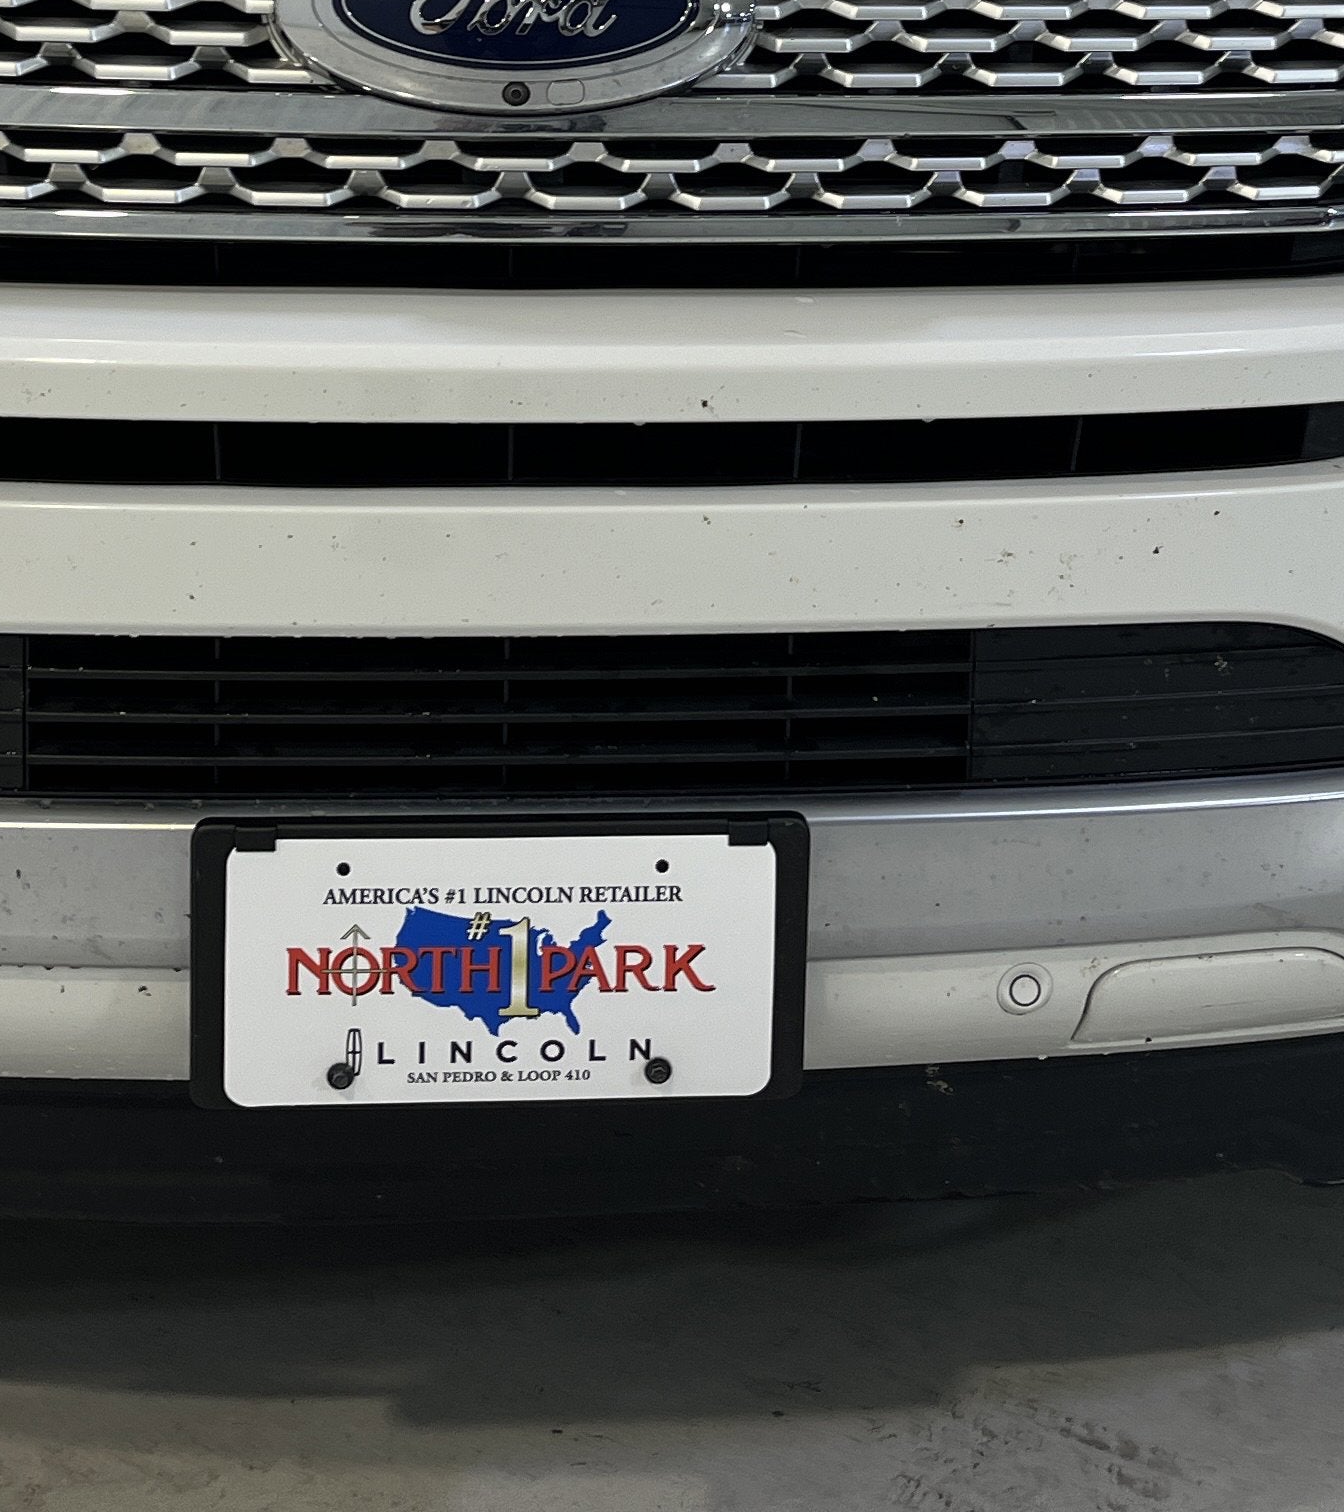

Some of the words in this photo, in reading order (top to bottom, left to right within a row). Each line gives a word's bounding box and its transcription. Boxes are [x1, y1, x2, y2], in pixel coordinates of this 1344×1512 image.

[322, 887, 440, 906] AMERICA'S
[444, 887, 467, 905] #1
[472, 886, 574, 904] LINCOLN
[578, 885, 684, 903] RETAILER
[285, 945, 503, 997] NORTH
[538, 944, 717, 994] PARK
[376, 1038, 654, 1065] LINCOLN
[406, 1071, 438, 1084] SAN
[443, 1070, 497, 1084] PEDRO
[500, 1070, 515, 1083] &
[517, 1069, 561, 1082] LOOP
[564, 1068, 592, 1081] 410
